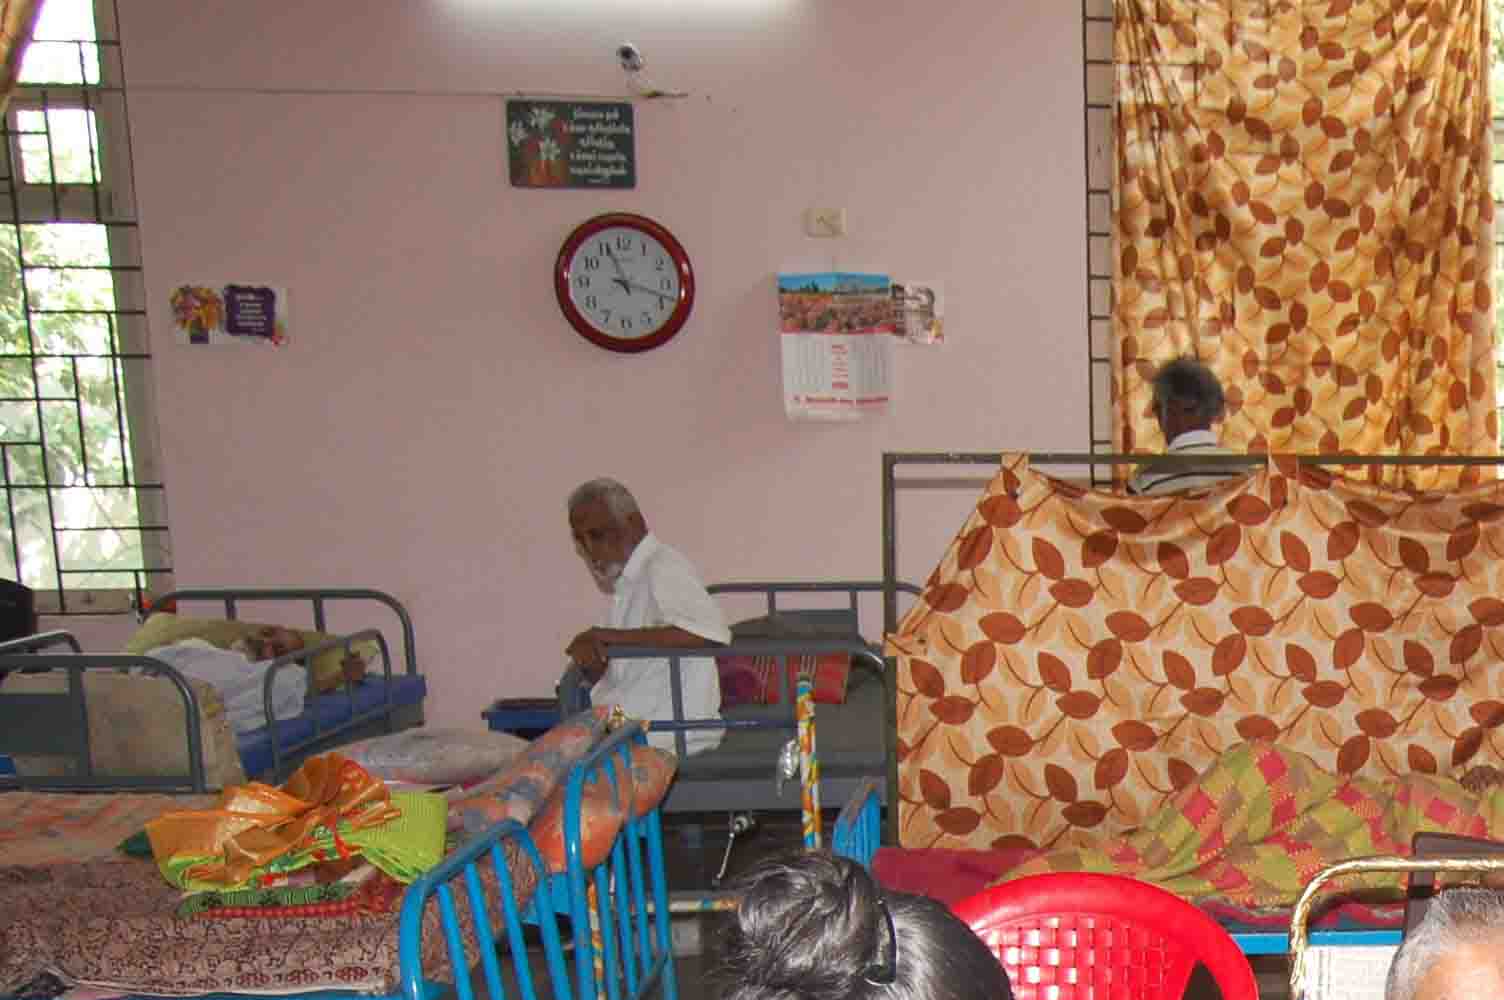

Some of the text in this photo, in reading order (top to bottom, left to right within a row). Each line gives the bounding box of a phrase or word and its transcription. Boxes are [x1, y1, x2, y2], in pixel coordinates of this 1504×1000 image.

[616, 235, 632, 251] 12
[641, 242, 647, 257] 1
[584, 256, 600, 270] 10
